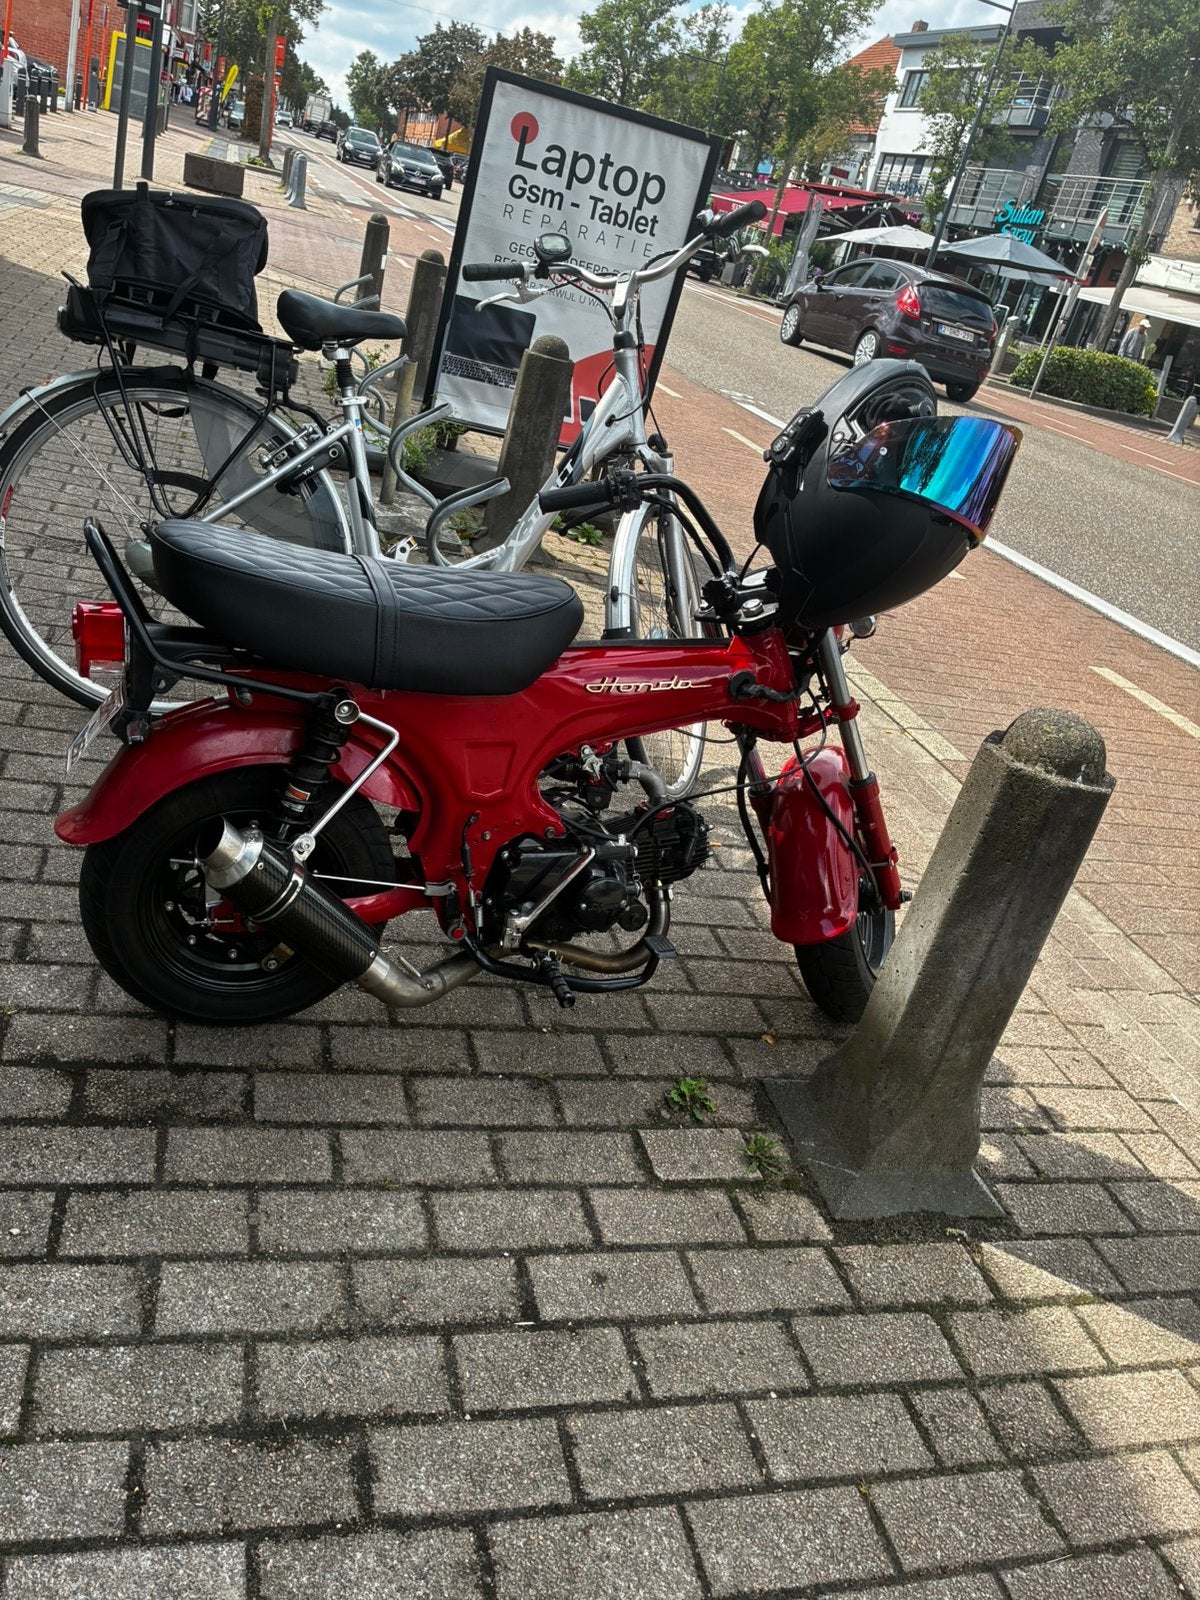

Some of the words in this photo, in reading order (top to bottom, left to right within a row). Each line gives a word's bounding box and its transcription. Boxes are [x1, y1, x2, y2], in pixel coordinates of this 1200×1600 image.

[515, 125, 666, 211] Laptop
[502, 203, 654, 258] REPARATIE
[508, 174, 564, 211] Gsm
[589, 195, 659, 237] Tablet
[996, 198, 1045, 226] Sultan
[586, 675, 712, 693] Honda
